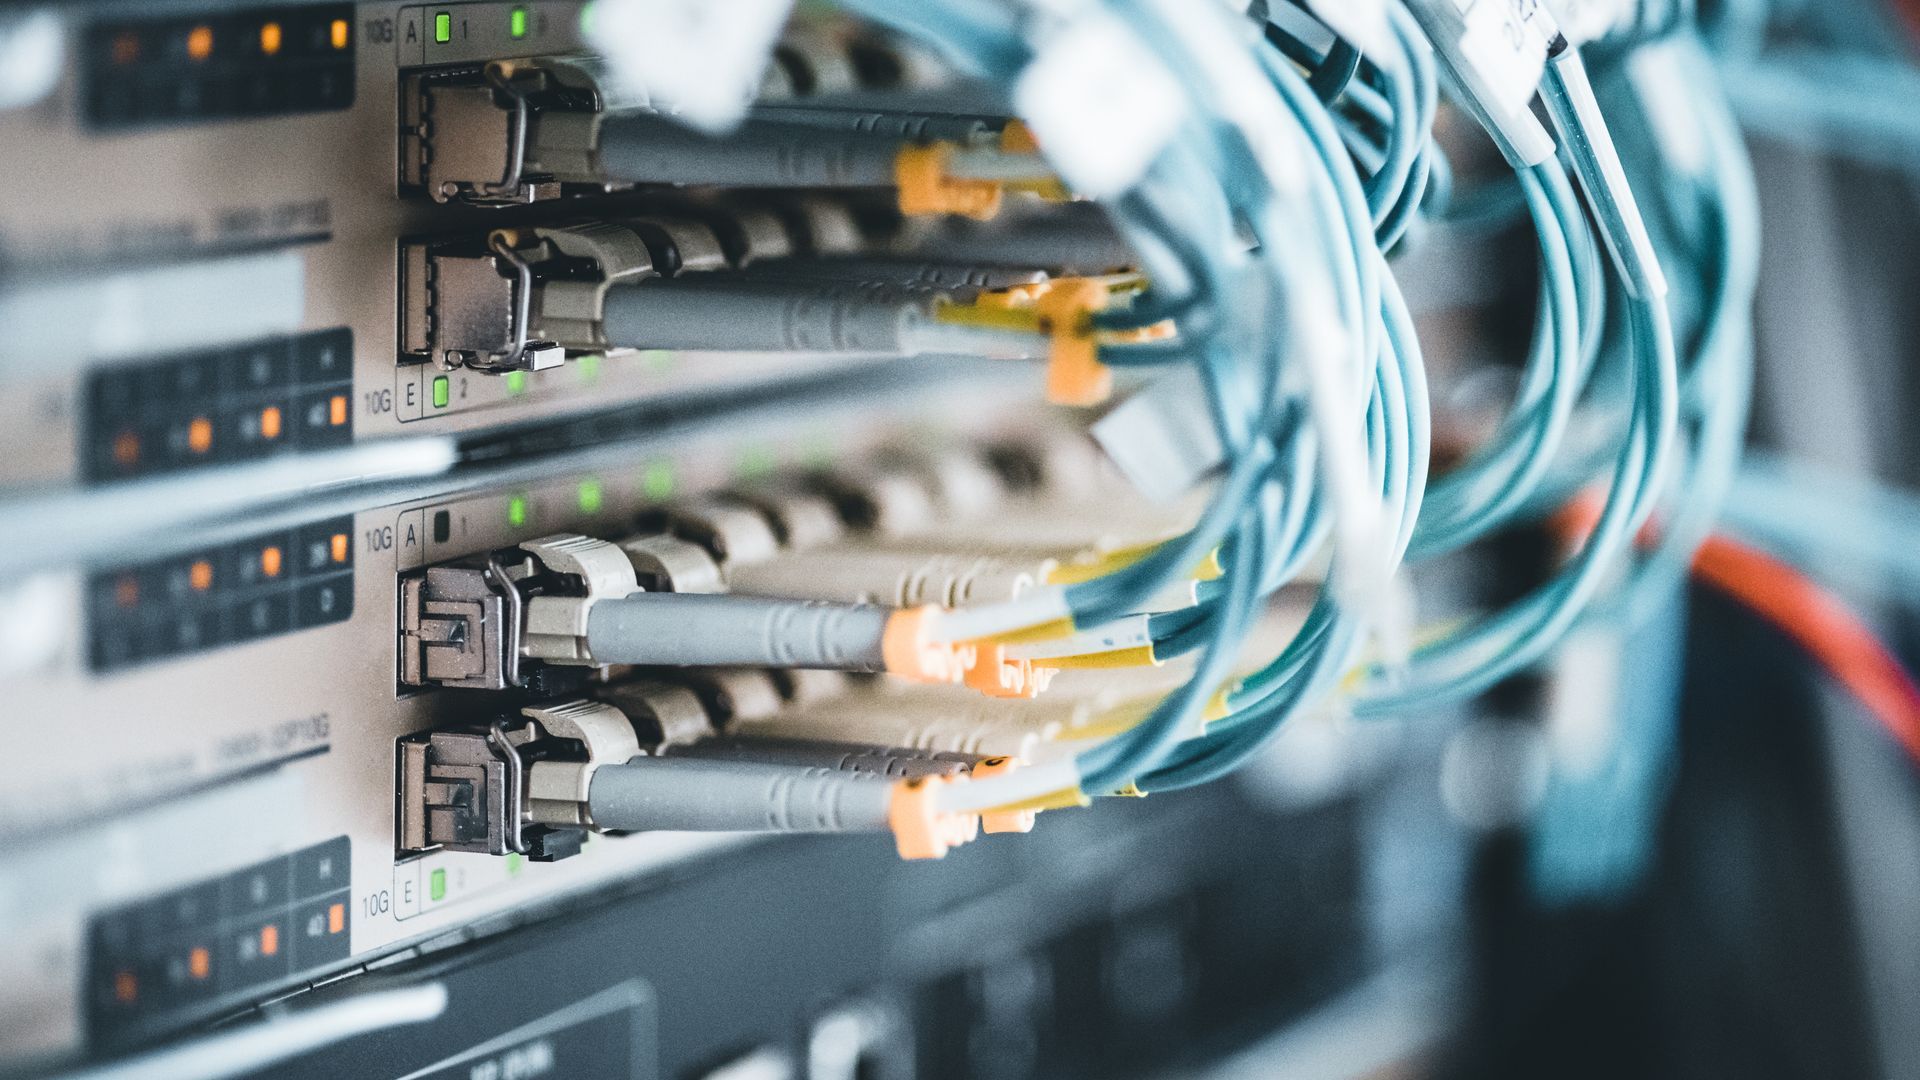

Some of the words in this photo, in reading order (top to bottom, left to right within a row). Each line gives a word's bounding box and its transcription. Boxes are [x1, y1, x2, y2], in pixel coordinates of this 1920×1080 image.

[366, 18, 393, 44] 10G
[405, 20, 418, 44] A
[462, 19, 468, 41] 1
[365, 388, 392, 415] 10G
[406, 382, 415, 406] E
[365, 525, 392, 552] 10G
[405, 523, 417, 547] A
[363, 889, 389, 919] 10G
[404, 880, 413, 904] E
